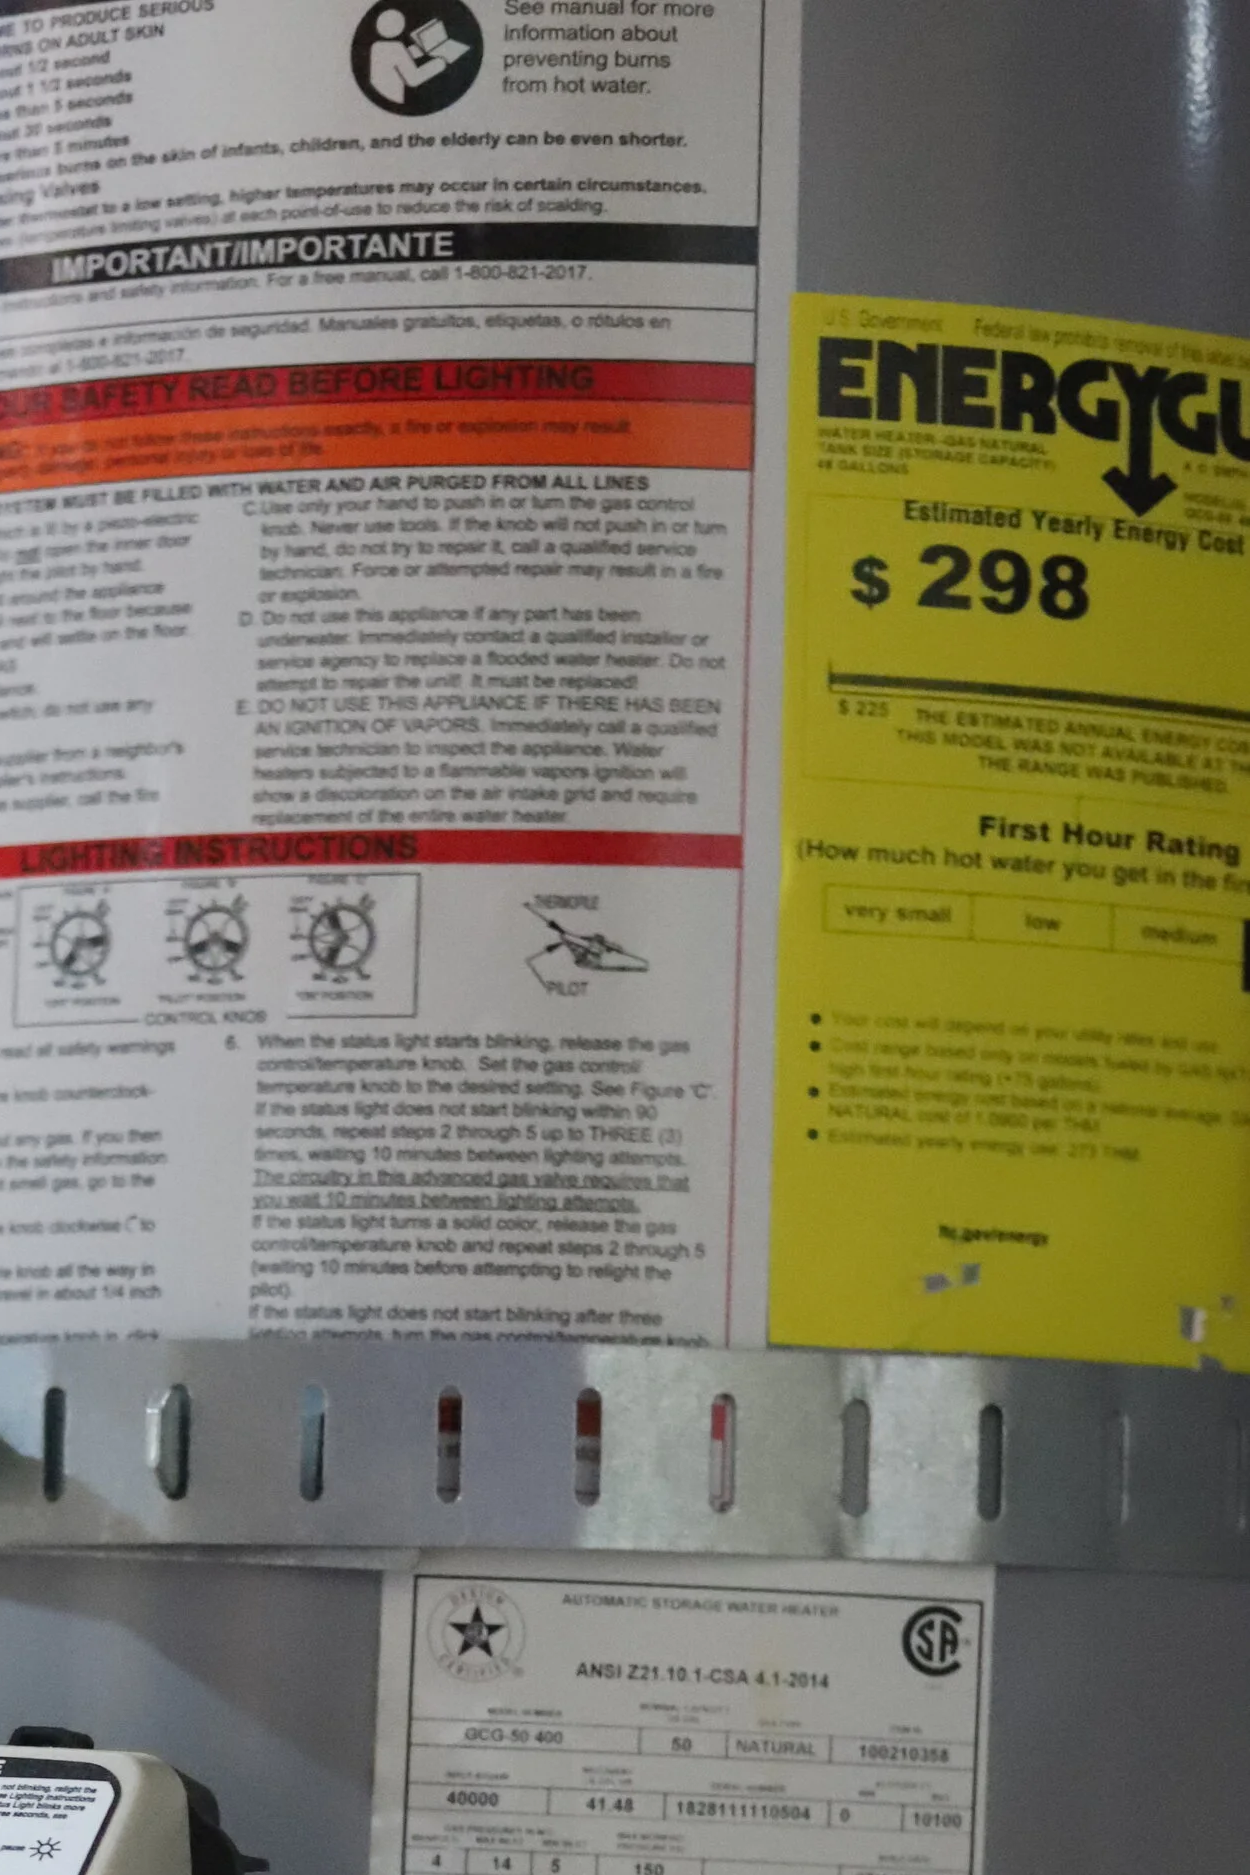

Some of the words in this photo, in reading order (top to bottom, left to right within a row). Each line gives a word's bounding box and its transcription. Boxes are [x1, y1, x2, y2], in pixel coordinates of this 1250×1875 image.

[504, 0, 543, 16] See
[550, 0, 624, 15] manual
[630, 0, 654, 16] for
[660, 3, 714, 18] more
[504, 24, 614, 42] information
[621, 26, 678, 42] about
[503, 50, 608, 71] preventing
[503, 76, 546, 93] from
[552, 77, 584, 94] hot
[590, 78, 651, 95] water.
[52, 230, 455, 283] IMPORTANT/IMPORTANTE
[60, 379, 175, 416] SAFETY
[188, 371, 277, 402] READ
[288, 367, 422, 398] BEFORE
[434, 364, 595, 393] LIGHTING
[258, 476, 320, 496] WATER
[325, 476, 364, 494] AND
[369, 476, 401, 492] AIR
[406, 474, 486, 491] PURGED
[492, 474, 547, 490] FROM
[553, 474, 587, 490] ALL
[594, 474, 649, 491] LINES
[903, 500, 1022, 533] Estimated
[1030, 510, 1105, 543] Yearly
[1113, 518, 1190, 553] Energy
[1198, 528, 1245, 557] Cost
[851, 554, 892, 611] $
[916, 542, 1091, 622] 298
[978, 815, 1051, 843] First
[1062, 822, 1134, 849] Hour
[1146, 830, 1240, 868] Rating
[18, 839, 164, 873] LIGHTING
[174, 833, 419, 867] INSTRUCTIONS
[797, 838, 859, 862] (How
[867, 843, 936, 867] much
[943, 846, 983, 871] hot
[990, 852, 1055, 874] water
[1063, 858, 1106, 884] you
[1114, 862, 1149, 887] get
[1156, 868, 1176, 886] in
[1181, 868, 1219, 891] the
[844, 903, 888, 924] very
[896, 906, 953, 923] small
[1024, 913, 1061, 933] low
[1140, 922, 1219, 946] medium
[576, 1662, 621, 1678] ANSI
[754, 1670, 829, 1688] 4.1-2014
[672, 1738, 692, 1752] 50
[736, 1740, 815, 1756] NATURAL
[446, 1791, 498, 1806] 40000
[431, 1854, 442, 1867] 4
[493, 1857, 512, 1870] 14
[551, 1858, 561, 1872] 5
